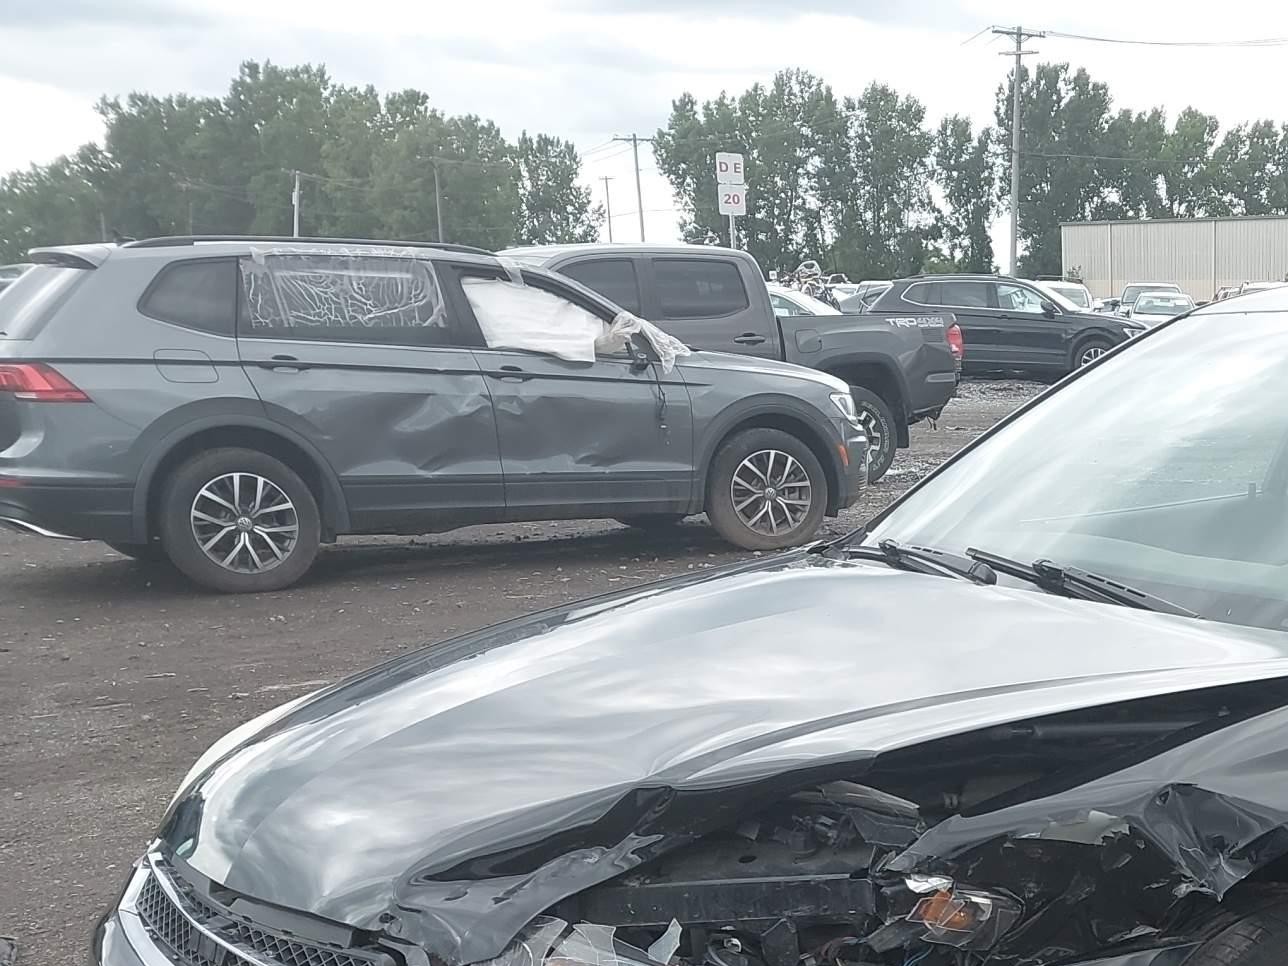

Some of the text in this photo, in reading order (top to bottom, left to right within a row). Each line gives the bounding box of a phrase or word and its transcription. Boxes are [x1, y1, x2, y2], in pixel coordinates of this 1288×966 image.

[719, 161, 742, 174] D E
[723, 193, 741, 205] 20
[884, 317, 917, 328] TRD
